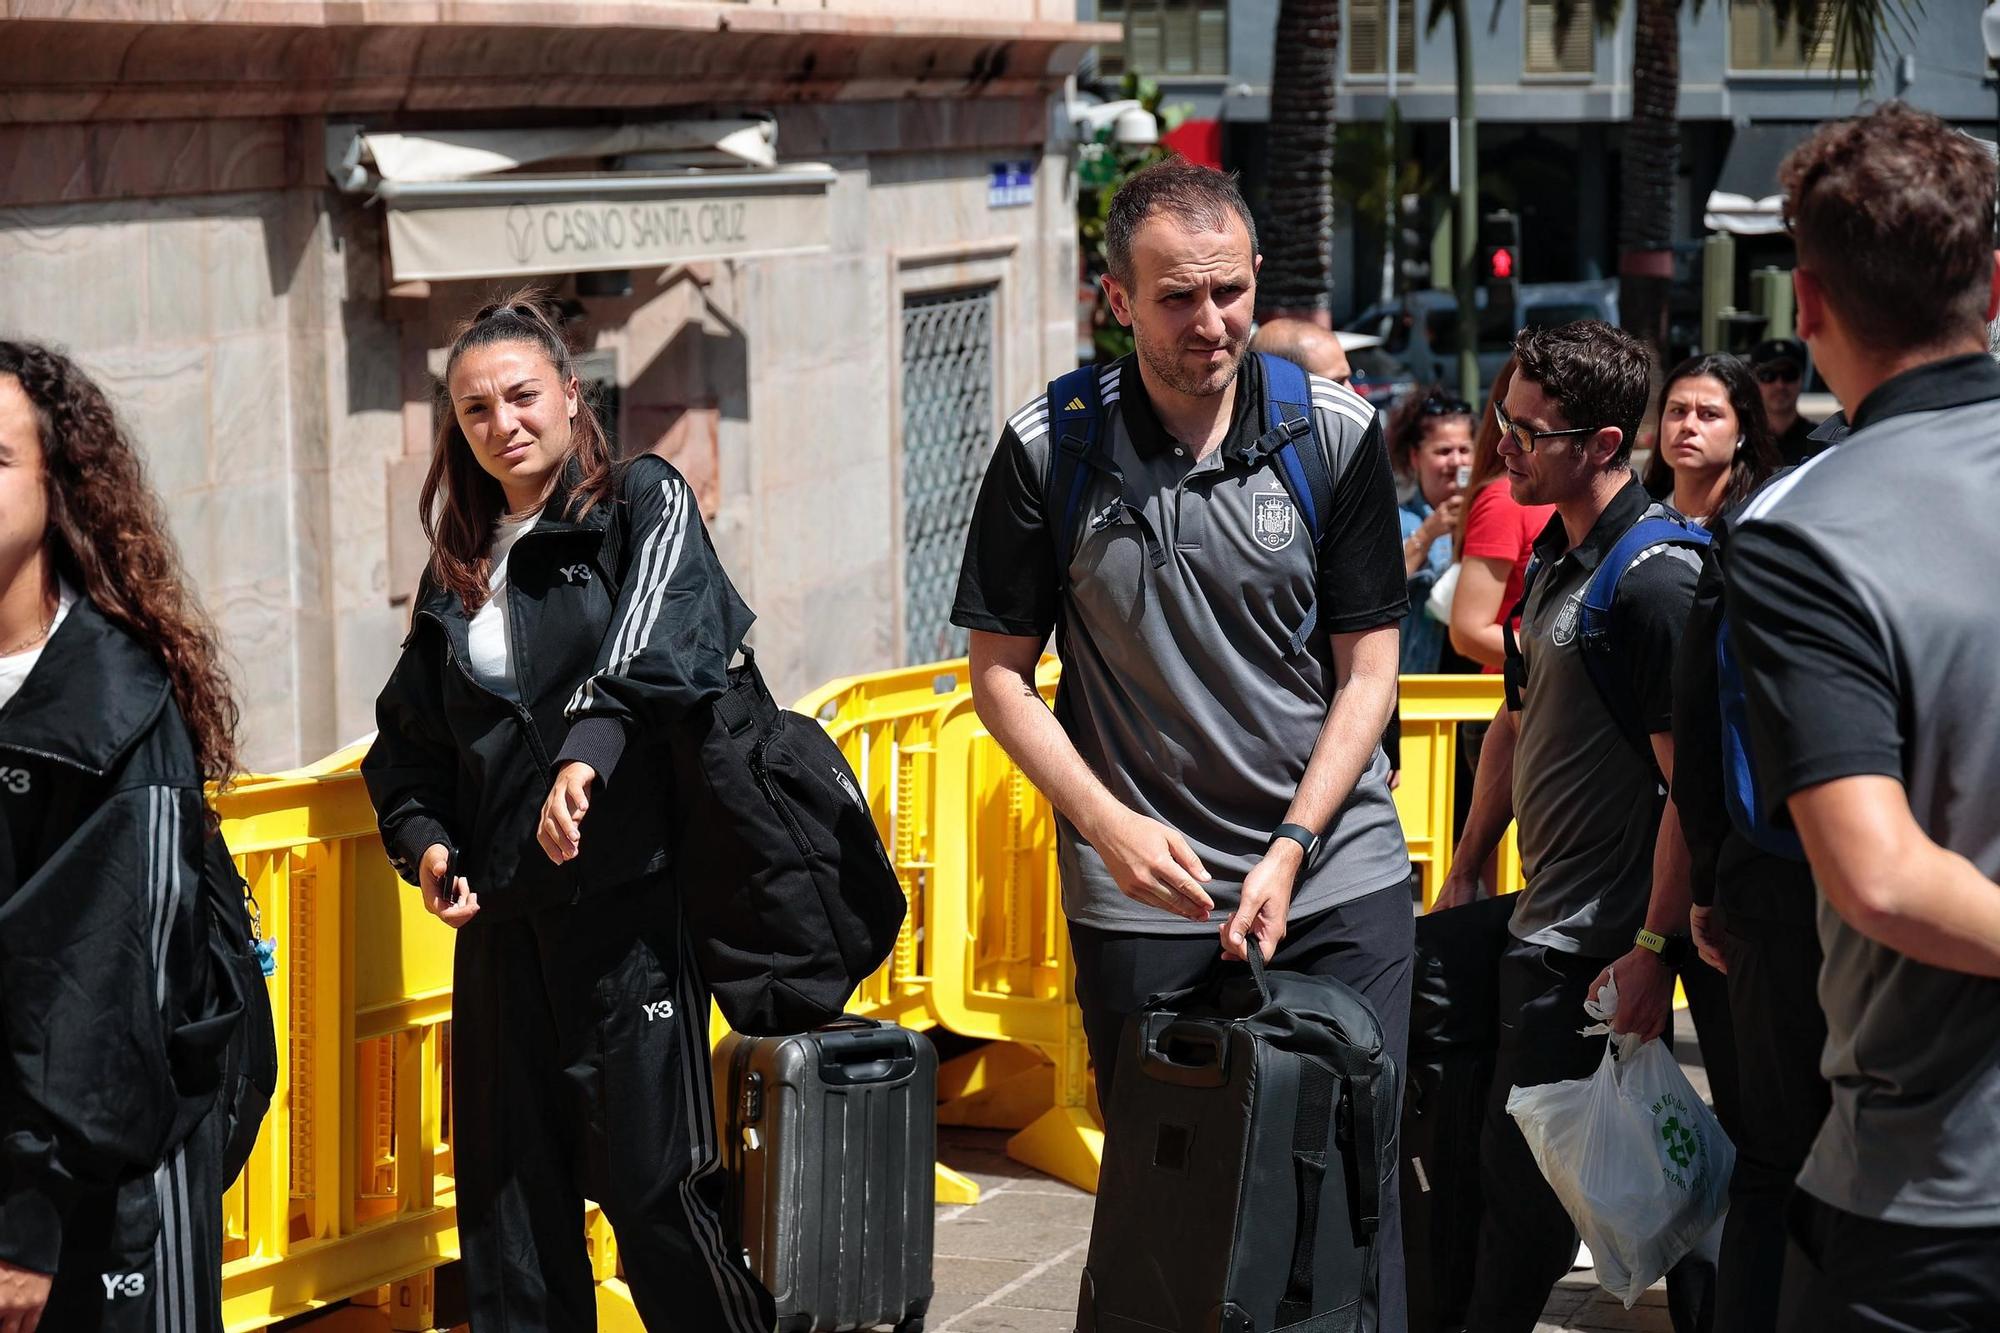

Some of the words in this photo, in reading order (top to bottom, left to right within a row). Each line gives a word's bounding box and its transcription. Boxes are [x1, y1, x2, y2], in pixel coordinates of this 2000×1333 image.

[542, 207, 626, 253] CASINO
[629, 206, 695, 248] SANTA
[697, 201, 747, 244] CRUZ
[560, 563, 592, 582] Y-3
[642, 1000, 674, 1021] Y-3
[101, 1272, 145, 1300] Y-3
